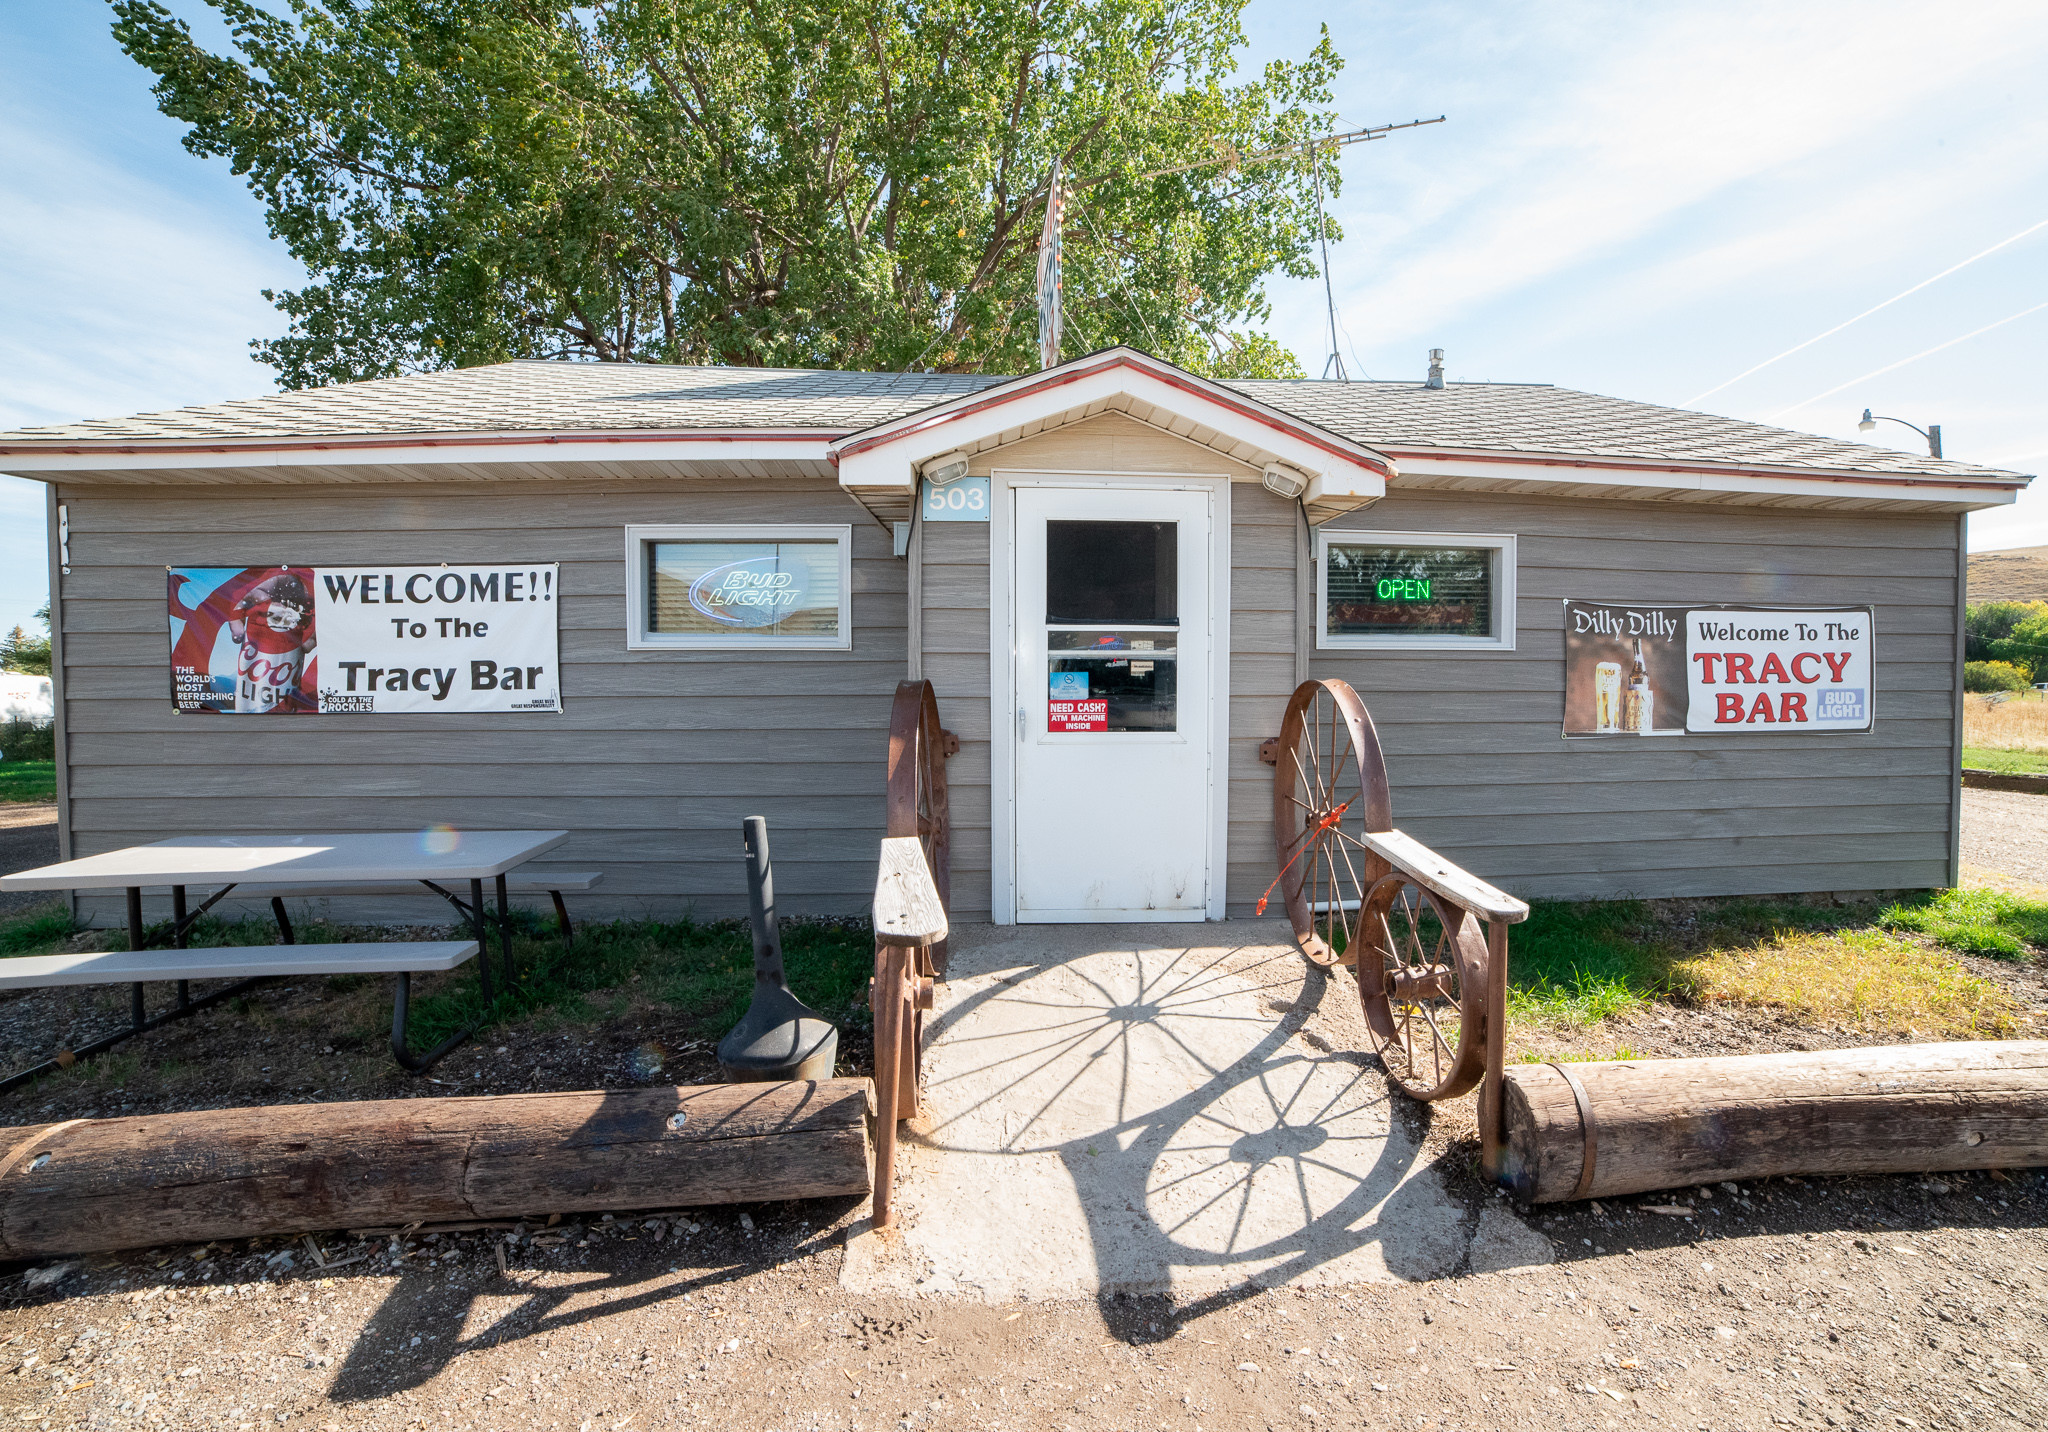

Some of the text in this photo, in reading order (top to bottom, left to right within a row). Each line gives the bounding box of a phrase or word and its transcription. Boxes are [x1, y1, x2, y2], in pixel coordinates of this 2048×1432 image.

[929, 487, 985, 511] 503
[323, 571, 552, 604] WELCOME!!
[722, 570, 793, 590] BUD
[1377, 579, 1430, 599] OPEN
[706, 588, 802, 606] LIGHT
[391, 617, 489, 639] To The
[1572, 608, 1678, 643] Dilly Dilly
[1698, 622, 1860, 641] Welcome To The
[175, 666, 195, 674] THE
[1692, 651, 1852, 684] TRACY
[175, 675, 217, 683] WORLD'S
[176, 684, 203, 692] MOST
[338, 660, 544, 701] Tracy Bar
[177, 692, 234, 701] REFRESHING
[1825, 691, 1856, 705] BUD
[327, 702, 373, 712] ROCKIES
[1050, 703, 1106, 712] NEED CASH?
[1714, 691, 1808, 724] BAR
[1818, 704, 1861, 718] LIGHT
[1065, 722, 1091, 730] INSIDE
